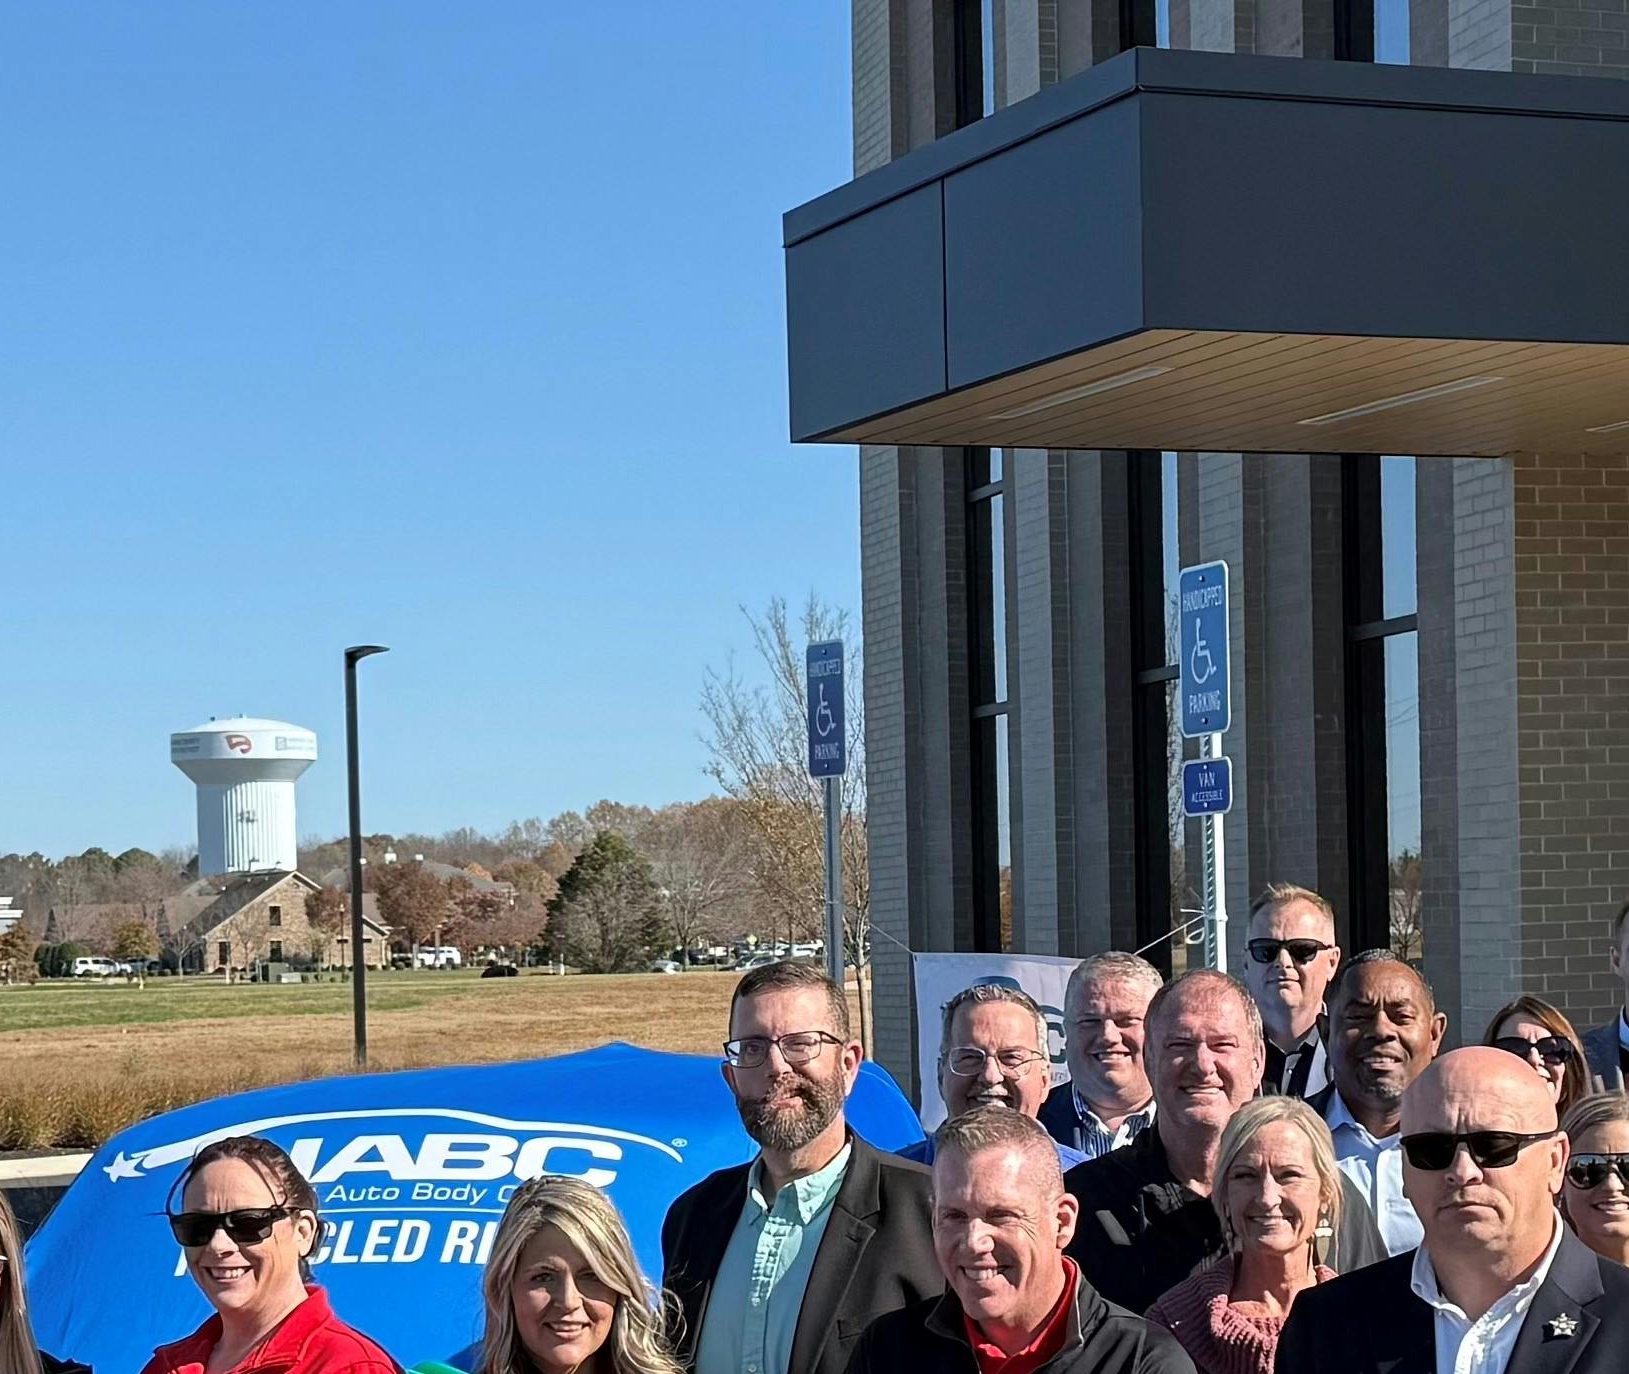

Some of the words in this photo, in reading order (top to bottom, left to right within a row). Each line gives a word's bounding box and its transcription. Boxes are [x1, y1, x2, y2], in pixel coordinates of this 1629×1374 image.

[1189, 690, 1221, 714] PARKING
[1198, 771, 1216, 788] VAN
[325, 1184, 401, 1202] Auto
[410, 1184, 489, 1205] Body
